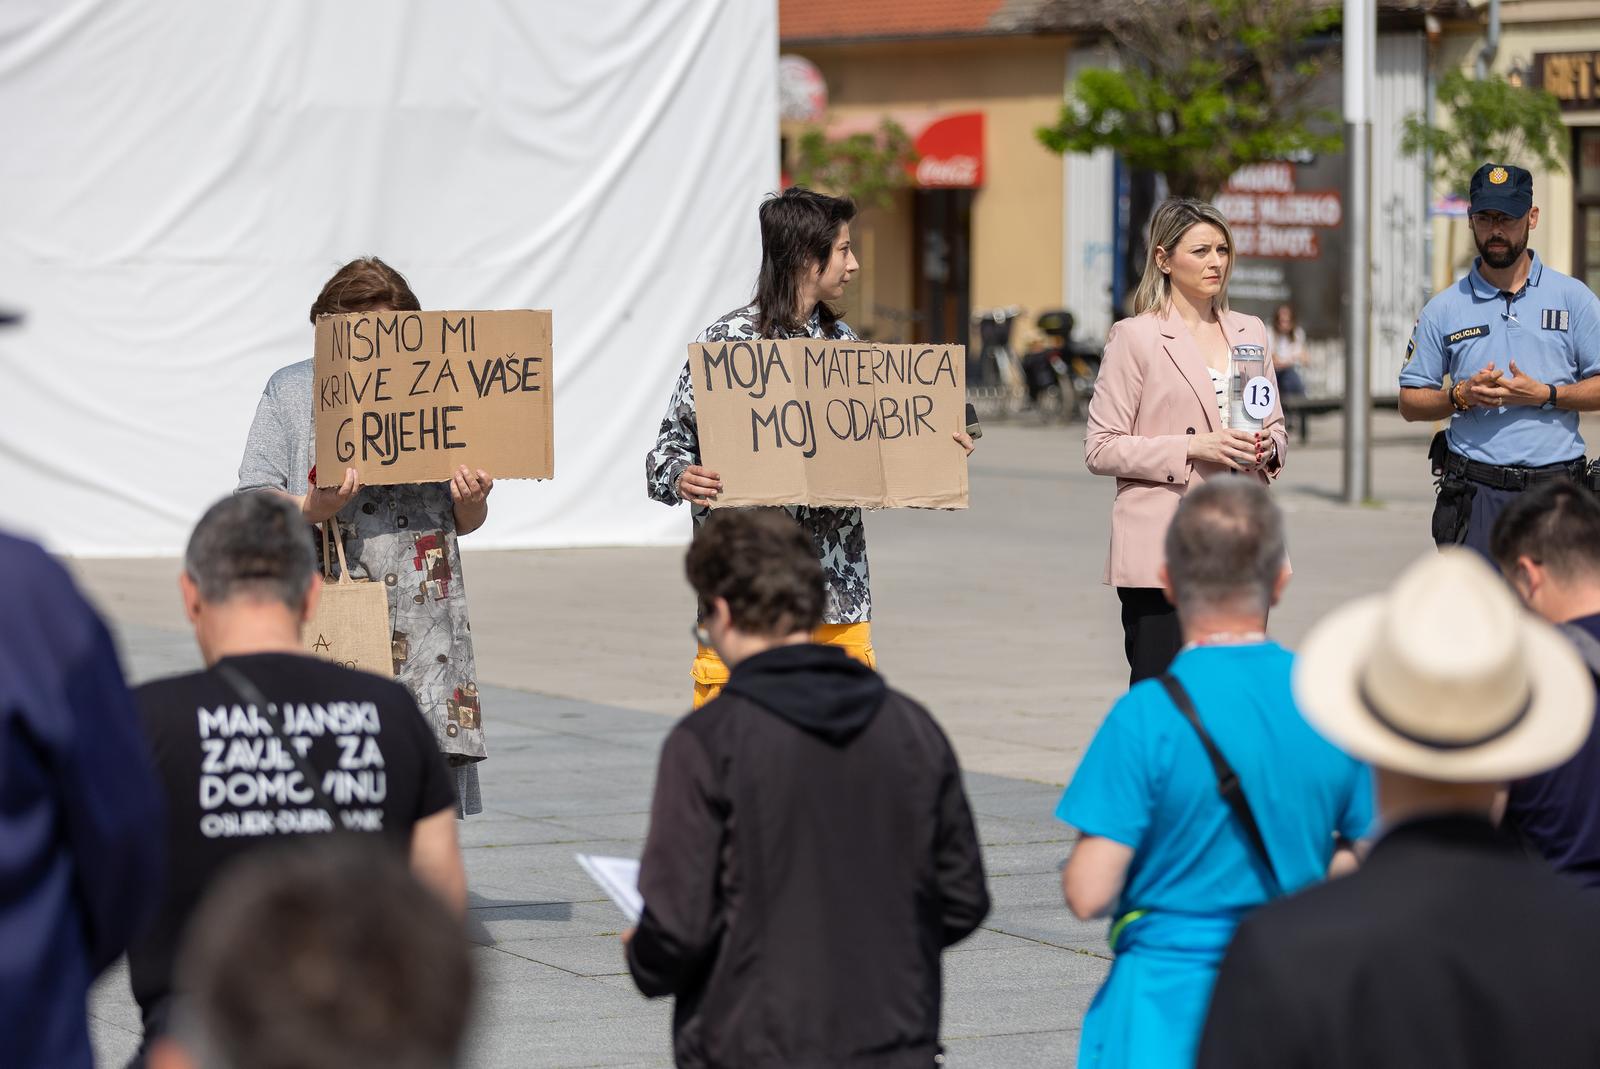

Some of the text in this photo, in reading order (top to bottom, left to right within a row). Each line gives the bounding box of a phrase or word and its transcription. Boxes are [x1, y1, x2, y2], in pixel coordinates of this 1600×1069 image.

[331, 314, 476, 362] NISMO MI
[1450, 328, 1481, 341] POLICIJA
[321, 352, 543, 411] KRIVE ZA VAŠE
[701, 342, 956, 398] MOJA MATERNICA
[1250, 385, 1270, 406] 13
[336, 406, 466, 465] GRIJEHE
[751, 395, 936, 458] MOJ ODABIR
[197, 701, 381, 738] MARJANSKI
[335, 734, 385, 769] ZA
